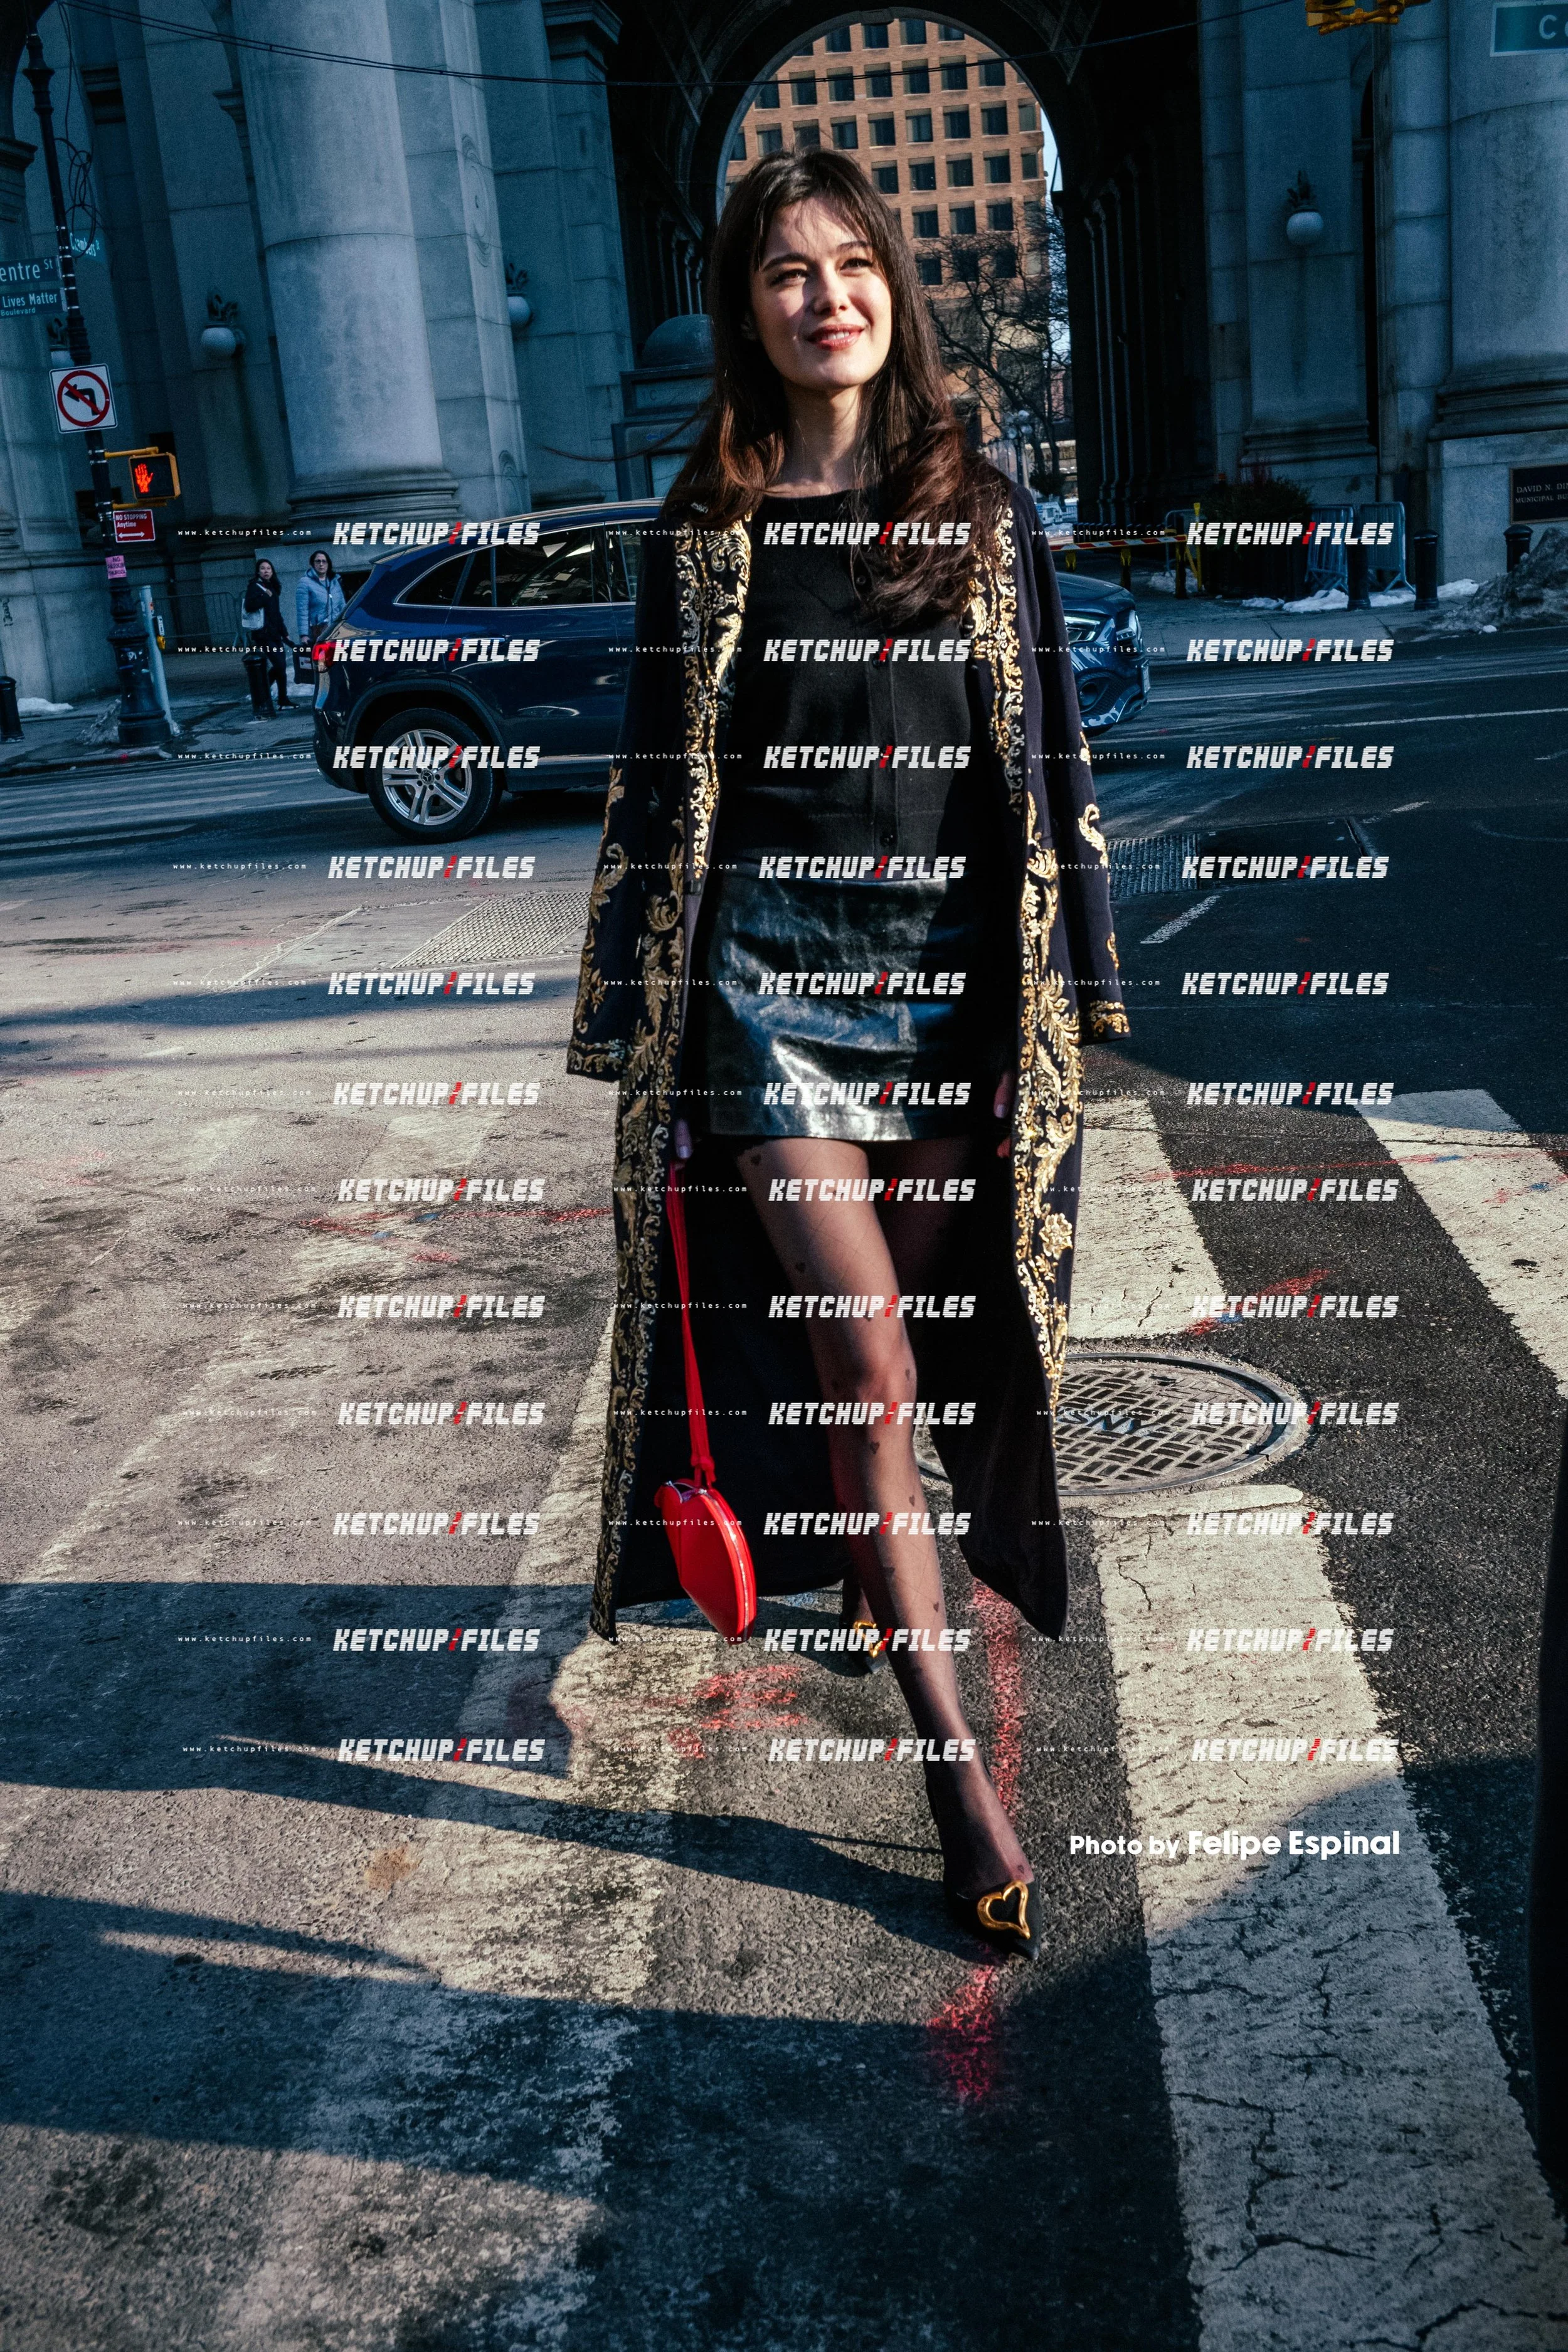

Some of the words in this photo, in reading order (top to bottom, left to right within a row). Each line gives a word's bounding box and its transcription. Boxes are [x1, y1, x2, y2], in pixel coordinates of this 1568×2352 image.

[43, 258, 54, 270] St
[2, 296, 26, 308] Lives
[29, 292, 58, 305] Matter
[1, 307, 36, 316] Boulevard
